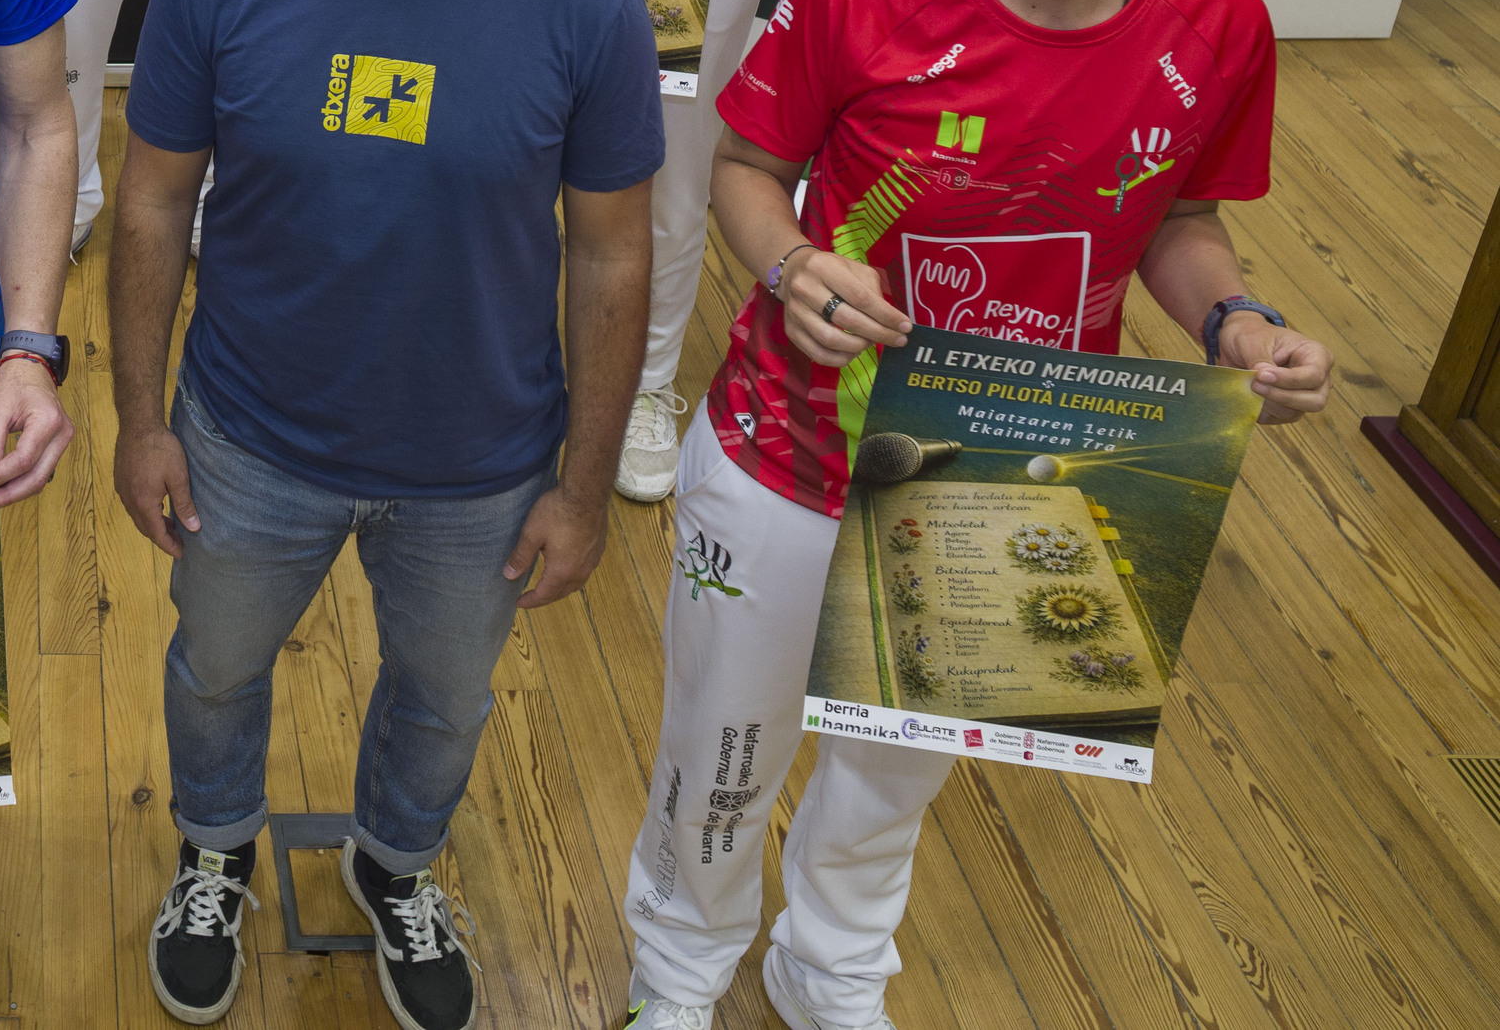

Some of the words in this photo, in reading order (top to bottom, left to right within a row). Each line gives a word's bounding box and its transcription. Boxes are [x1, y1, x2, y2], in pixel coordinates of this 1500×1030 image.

[926, 42, 966, 79] negua
[321, 53, 350, 132] etxera
[1157, 50, 1198, 110] berria
[931, 150, 977, 165] hamaika
[983, 299, 1061, 329] Reyno
[914, 346, 937, 365] II.
[944, 350, 1037, 376] ETXEKO
[1041, 362, 1187, 396] MEMORIALA
[907, 372, 982, 396] BERTSO
[986, 382, 1053, 406] PILOTA
[1059, 392, 1165, 422] LEHIAKETA
[957, 405, 1074, 432] Maiatzaren
[1082, 423, 1138, 441] 1etik
[969, 421, 1071, 446] Ekainaren
[1082, 437, 1116, 453] 7ra
[825, 700, 869, 718] berria
[822, 717, 899, 740] hamaika
[715, 726, 738, 786] Gobernua
[738, 723, 761, 787] Nafarroako
